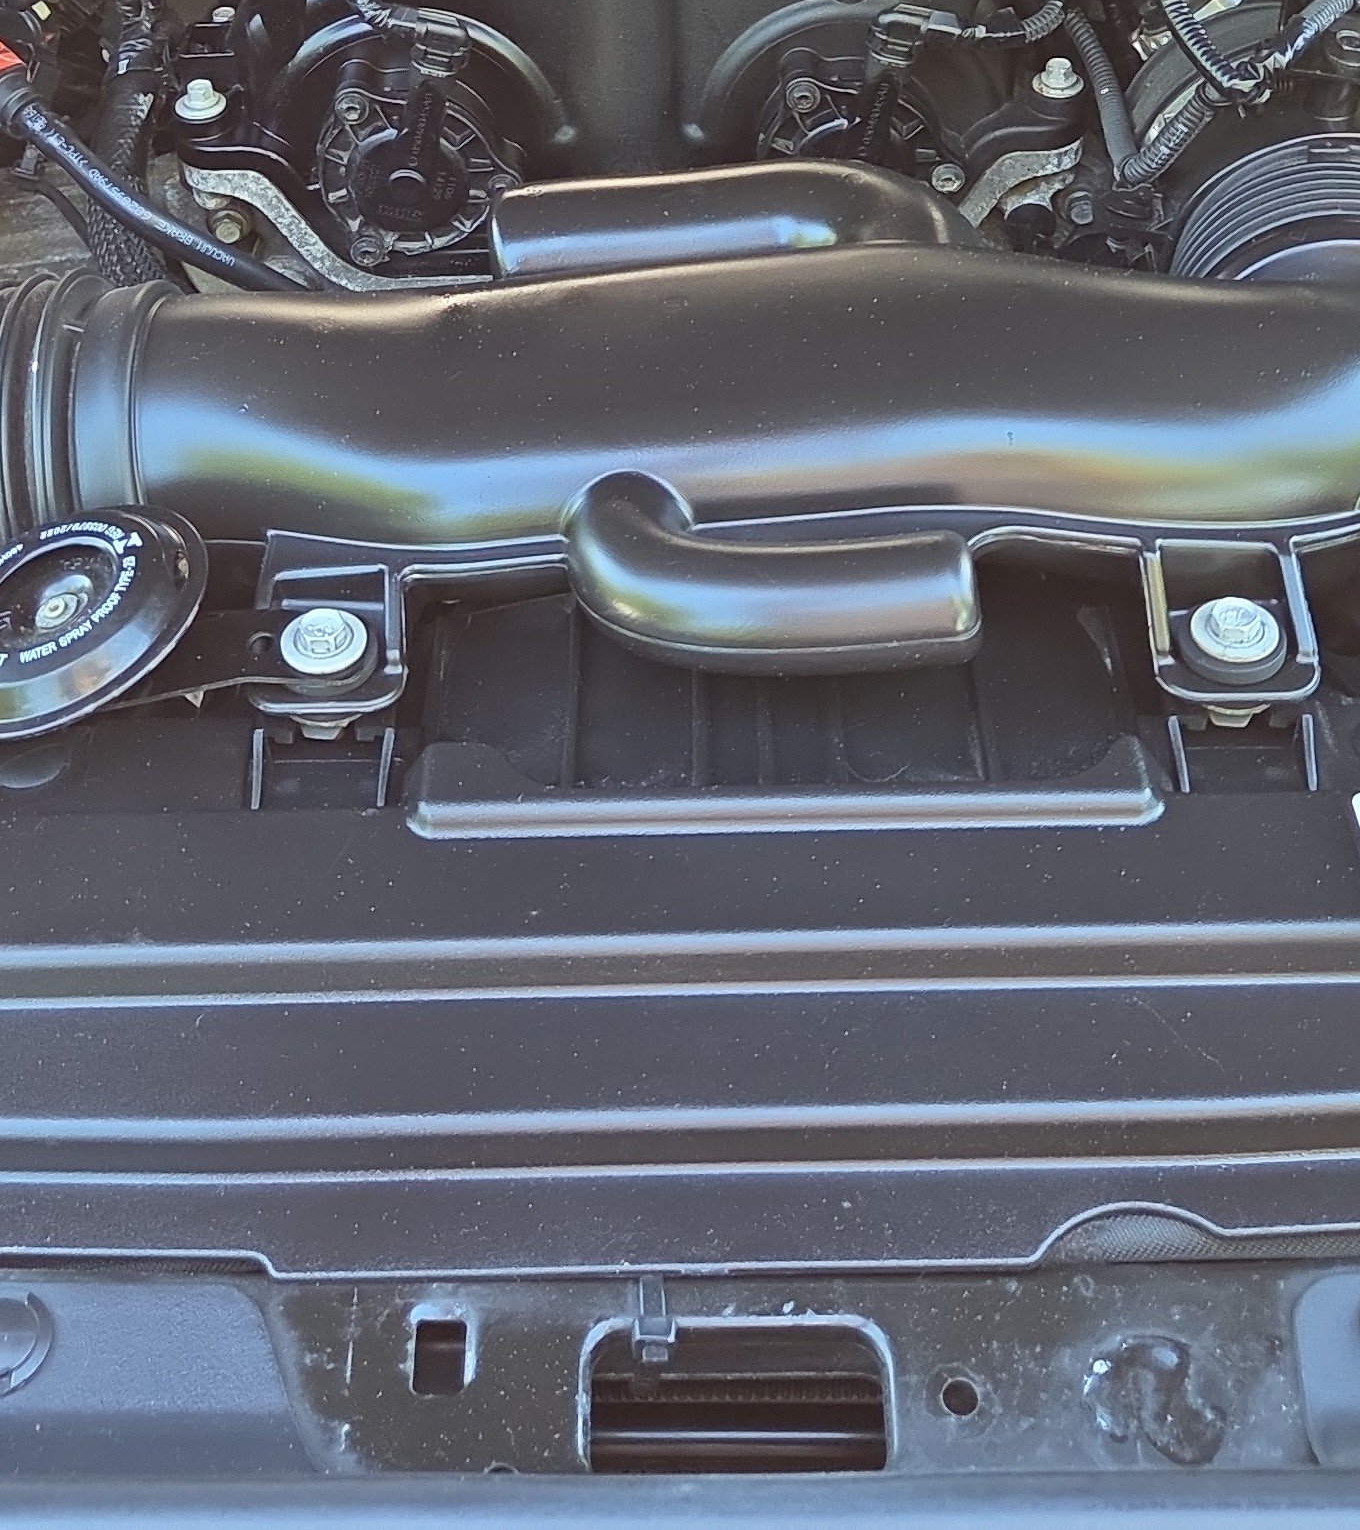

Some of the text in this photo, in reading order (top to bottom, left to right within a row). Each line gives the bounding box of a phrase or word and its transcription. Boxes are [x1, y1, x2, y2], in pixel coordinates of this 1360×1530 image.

[157, 221, 195, 246] BRAKE
[19, 641, 58, 664] WATER
[58, 620, 93, 648] SPRAY
[90, 591, 122, 623] PROOF
